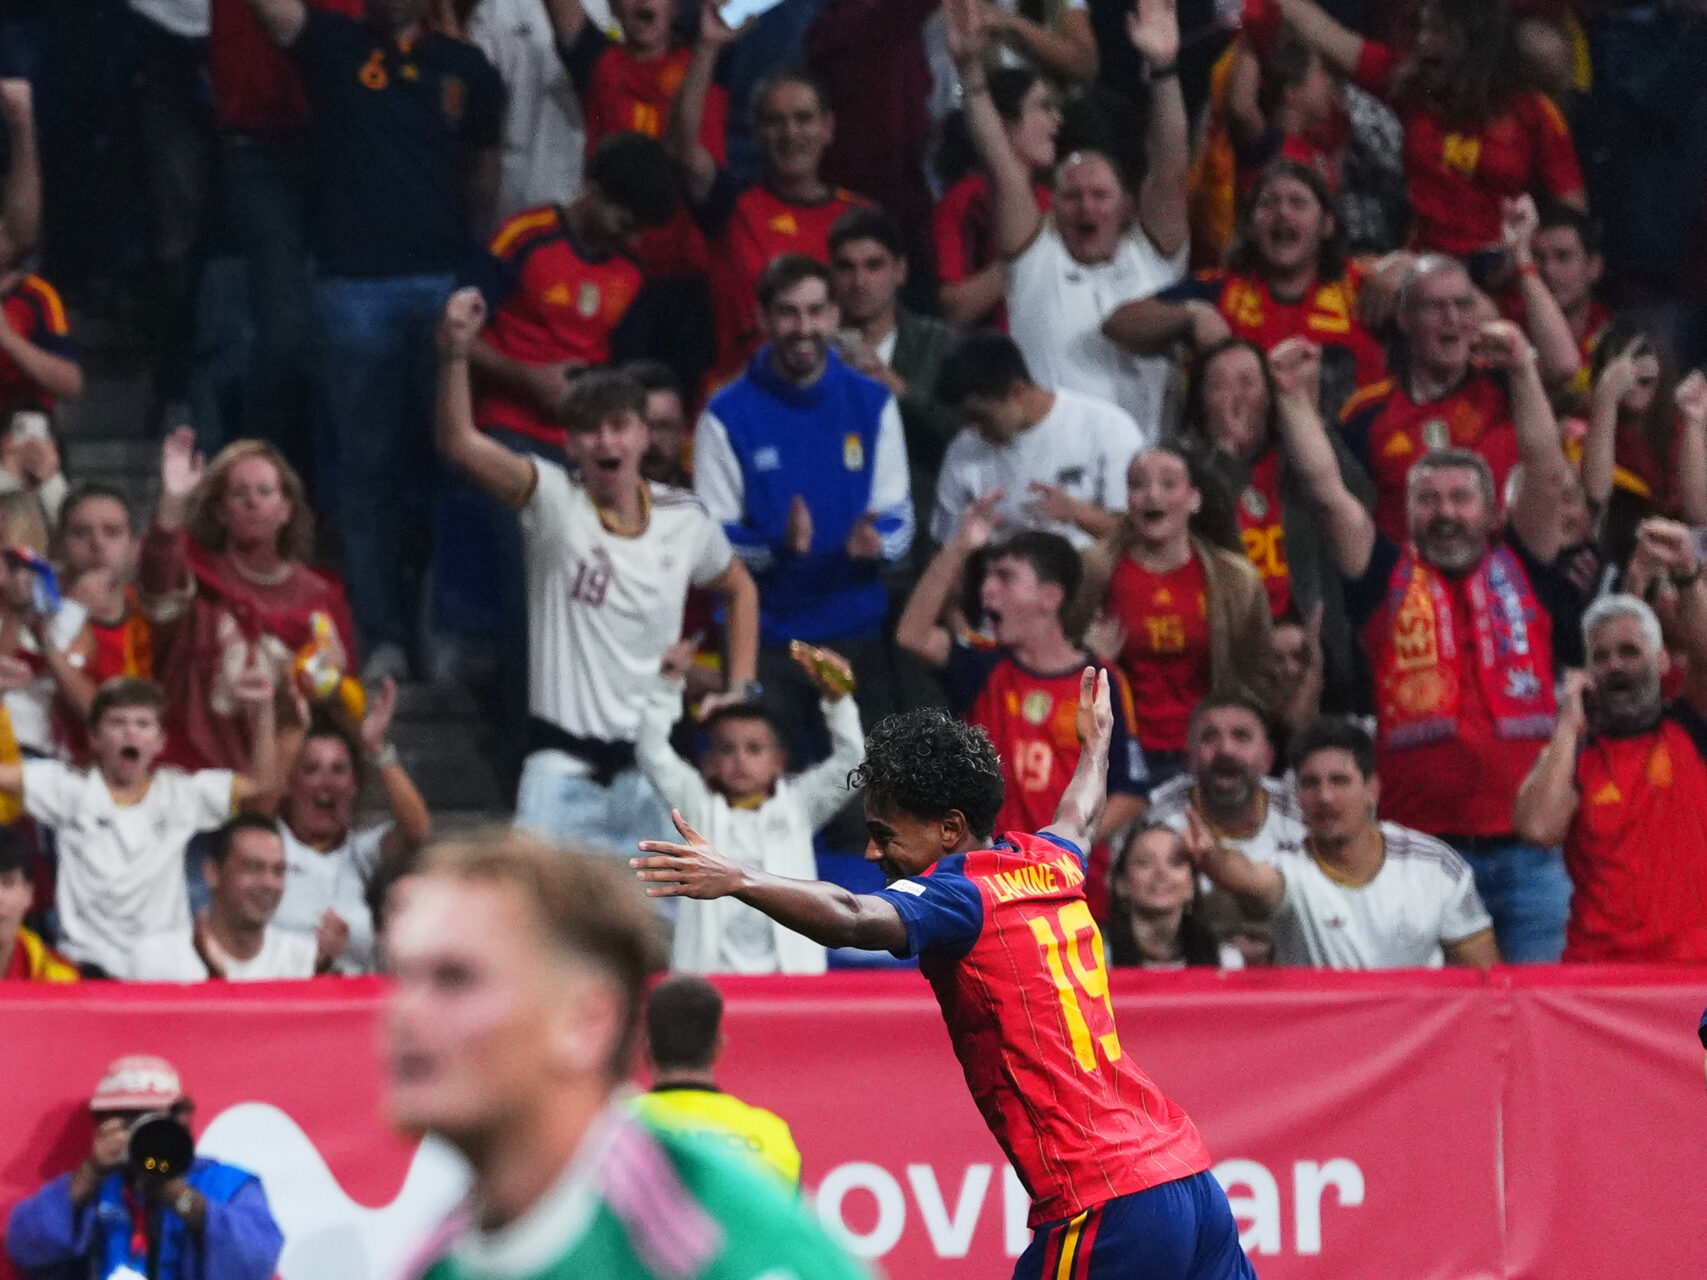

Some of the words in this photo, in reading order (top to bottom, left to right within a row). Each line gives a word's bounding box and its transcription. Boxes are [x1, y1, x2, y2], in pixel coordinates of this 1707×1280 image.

[1014, 740, 1053, 791] 19
[984, 864, 1060, 902] LAMINE
[1028, 900, 1121, 1073] 19
